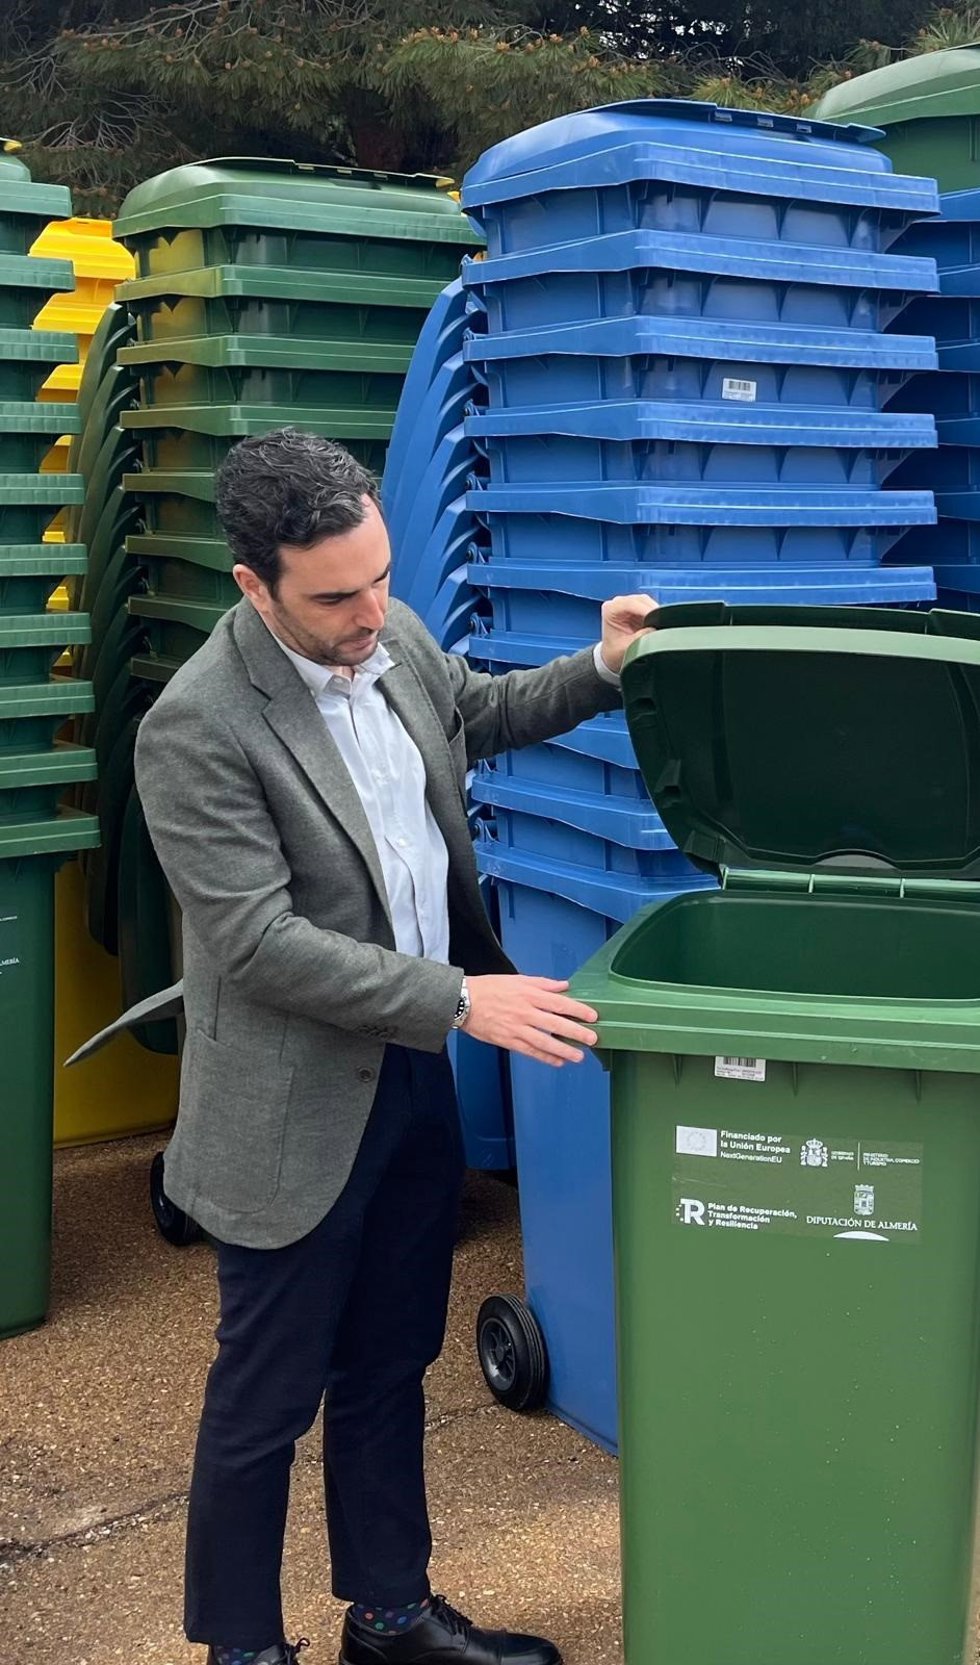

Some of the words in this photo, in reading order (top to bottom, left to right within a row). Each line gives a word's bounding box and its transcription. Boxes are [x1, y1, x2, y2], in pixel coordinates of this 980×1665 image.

[720, 1130, 766, 1141] Financiado
[720, 1140, 728, 1148] la
[730, 1141, 754, 1150] Unión
[756, 1143, 791, 1154] Europea
[708, 1202, 725, 1211] Plan
[727, 1204, 738, 1212] de
[739, 1206, 797, 1219] Recuperación,
[708, 1210, 770, 1223] Transformación
[715, 1219, 758, 1229] Resiliencia
[806, 1215, 862, 1227] DIPUTACIÓN
[864, 1220, 876, 1228] DE
[878, 1221, 918, 1231] ALMERÍA
